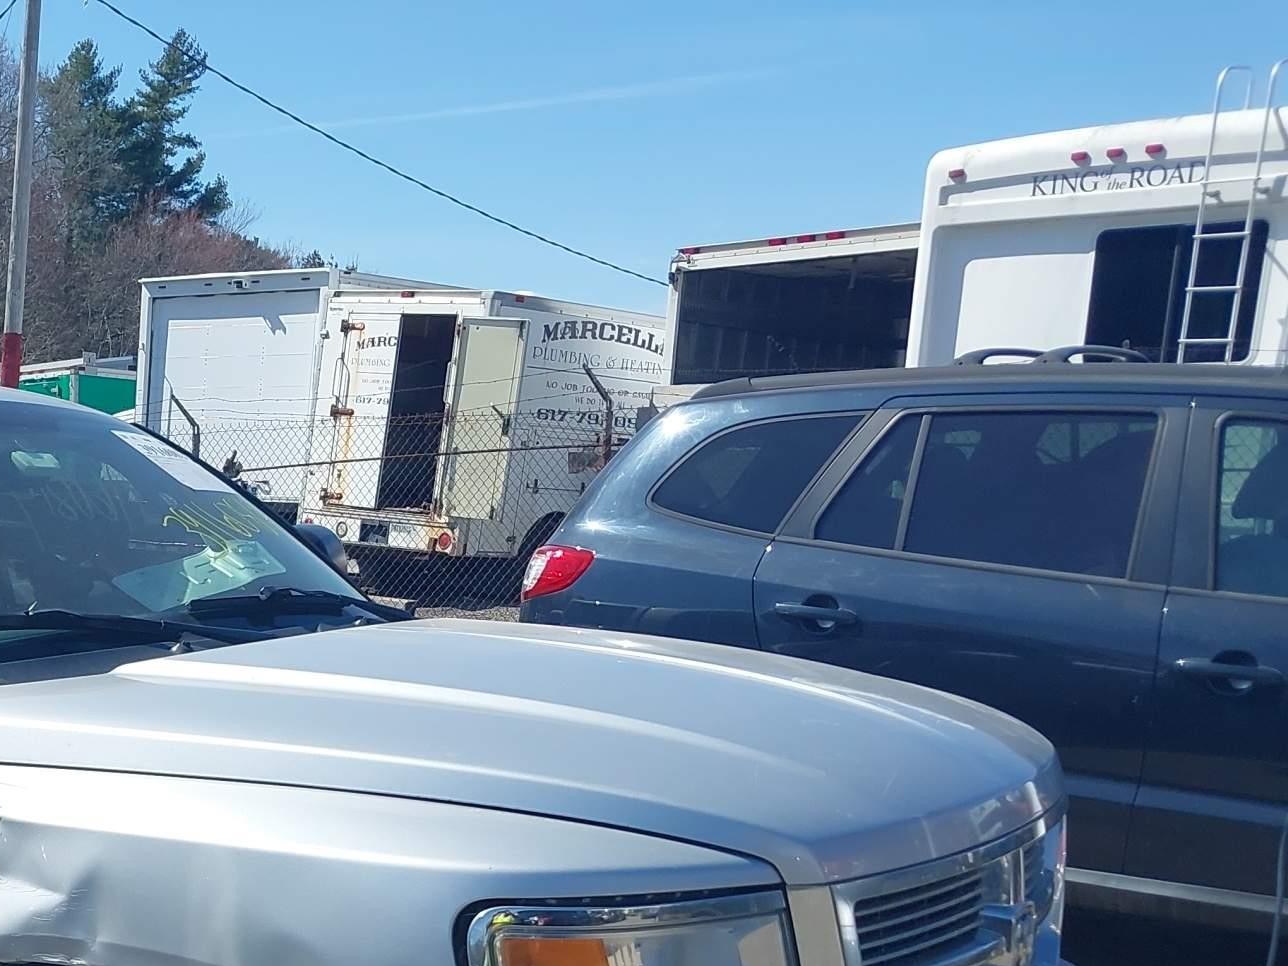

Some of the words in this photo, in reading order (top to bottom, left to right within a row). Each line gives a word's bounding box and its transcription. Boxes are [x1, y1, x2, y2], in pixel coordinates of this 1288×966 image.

[1031, 171, 1099, 196] KING
[1100, 168, 1113, 181] of
[1107, 178, 1127, 190] the
[1129, 160, 1206, 188] ROAD
[355, 336, 397, 351] MARC
[532, 346, 601, 368] PLUMBING
[561, 382, 578, 391] JOB
